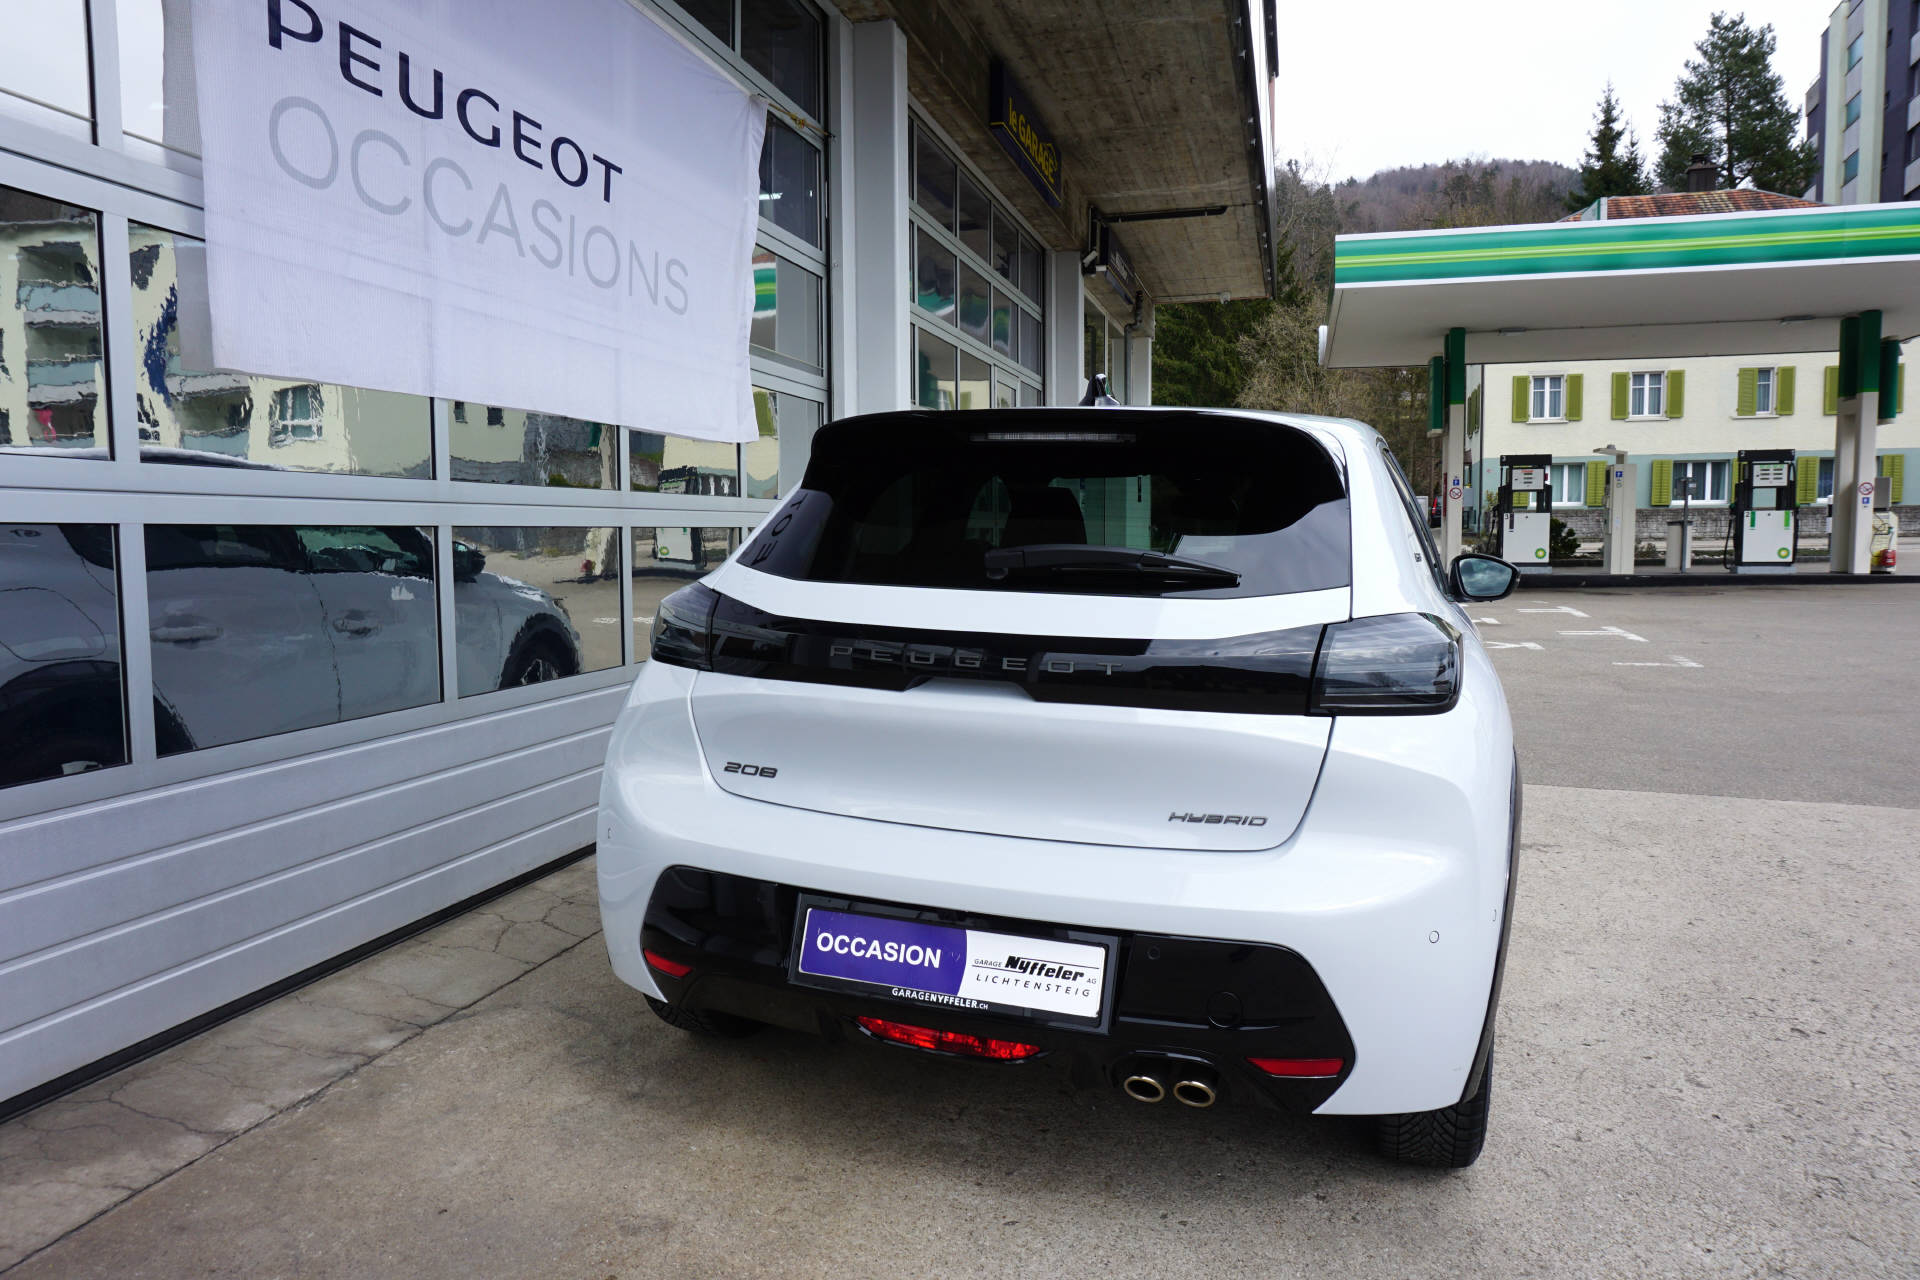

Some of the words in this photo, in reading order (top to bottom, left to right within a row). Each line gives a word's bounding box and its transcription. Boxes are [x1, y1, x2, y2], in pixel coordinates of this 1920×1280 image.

[267, 0, 623, 203] PEUGEOT
[1018, 113, 1056, 185] GARAGE
[268, 95, 690, 317] OCCASIONS
[829, 644, 1123, 676] PEUGEOT
[723, 761, 778, 779] 208
[1167, 811, 1269, 827] HYBRID
[815, 931, 943, 969] OCCASION
[973, 958, 1003, 968] GARAGE
[1004, 955, 1085, 981] Nyffeler
[1086, 977, 1097, 985] AG
[975, 973, 1091, 998] LICHTENSTEIG
[891, 987, 989, 1011] GARAGENYFFELER.CH
